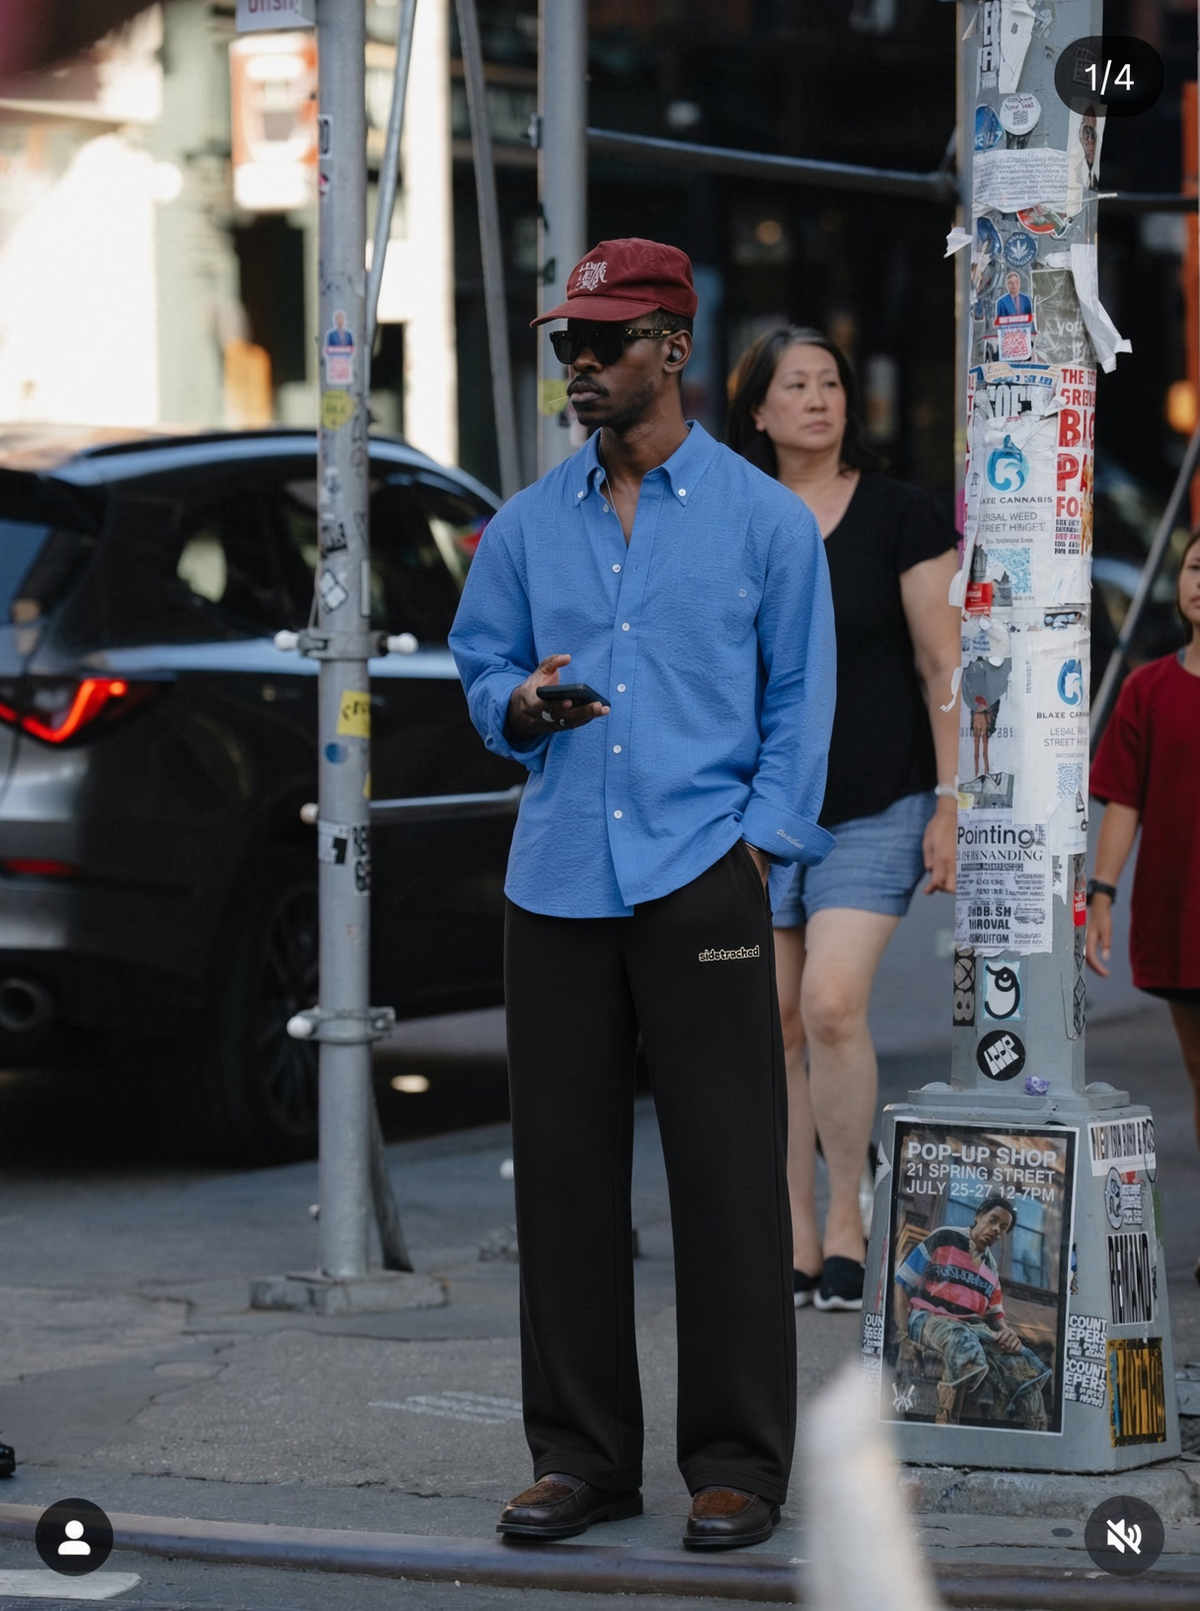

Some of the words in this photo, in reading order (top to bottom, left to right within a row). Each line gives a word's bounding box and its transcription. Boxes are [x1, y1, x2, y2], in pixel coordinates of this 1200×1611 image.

[1061, 368, 1085, 385] THE
[1043, 738, 1076, 747] STREET
[957, 825, 1034, 849] Pointing
[907, 1141, 991, 1164] POP-UP
[996, 1147, 1058, 1168] SHOP
[906, 1162, 923, 1177] 21
[929, 1163, 988, 1181] SPRING
[992, 1167, 1056, 1185] STREET
[906, 1180, 947, 1196] JULY
[950, 1182, 993, 1199] 25-27
[998, 1184, 1055, 1202] 12-7PM
